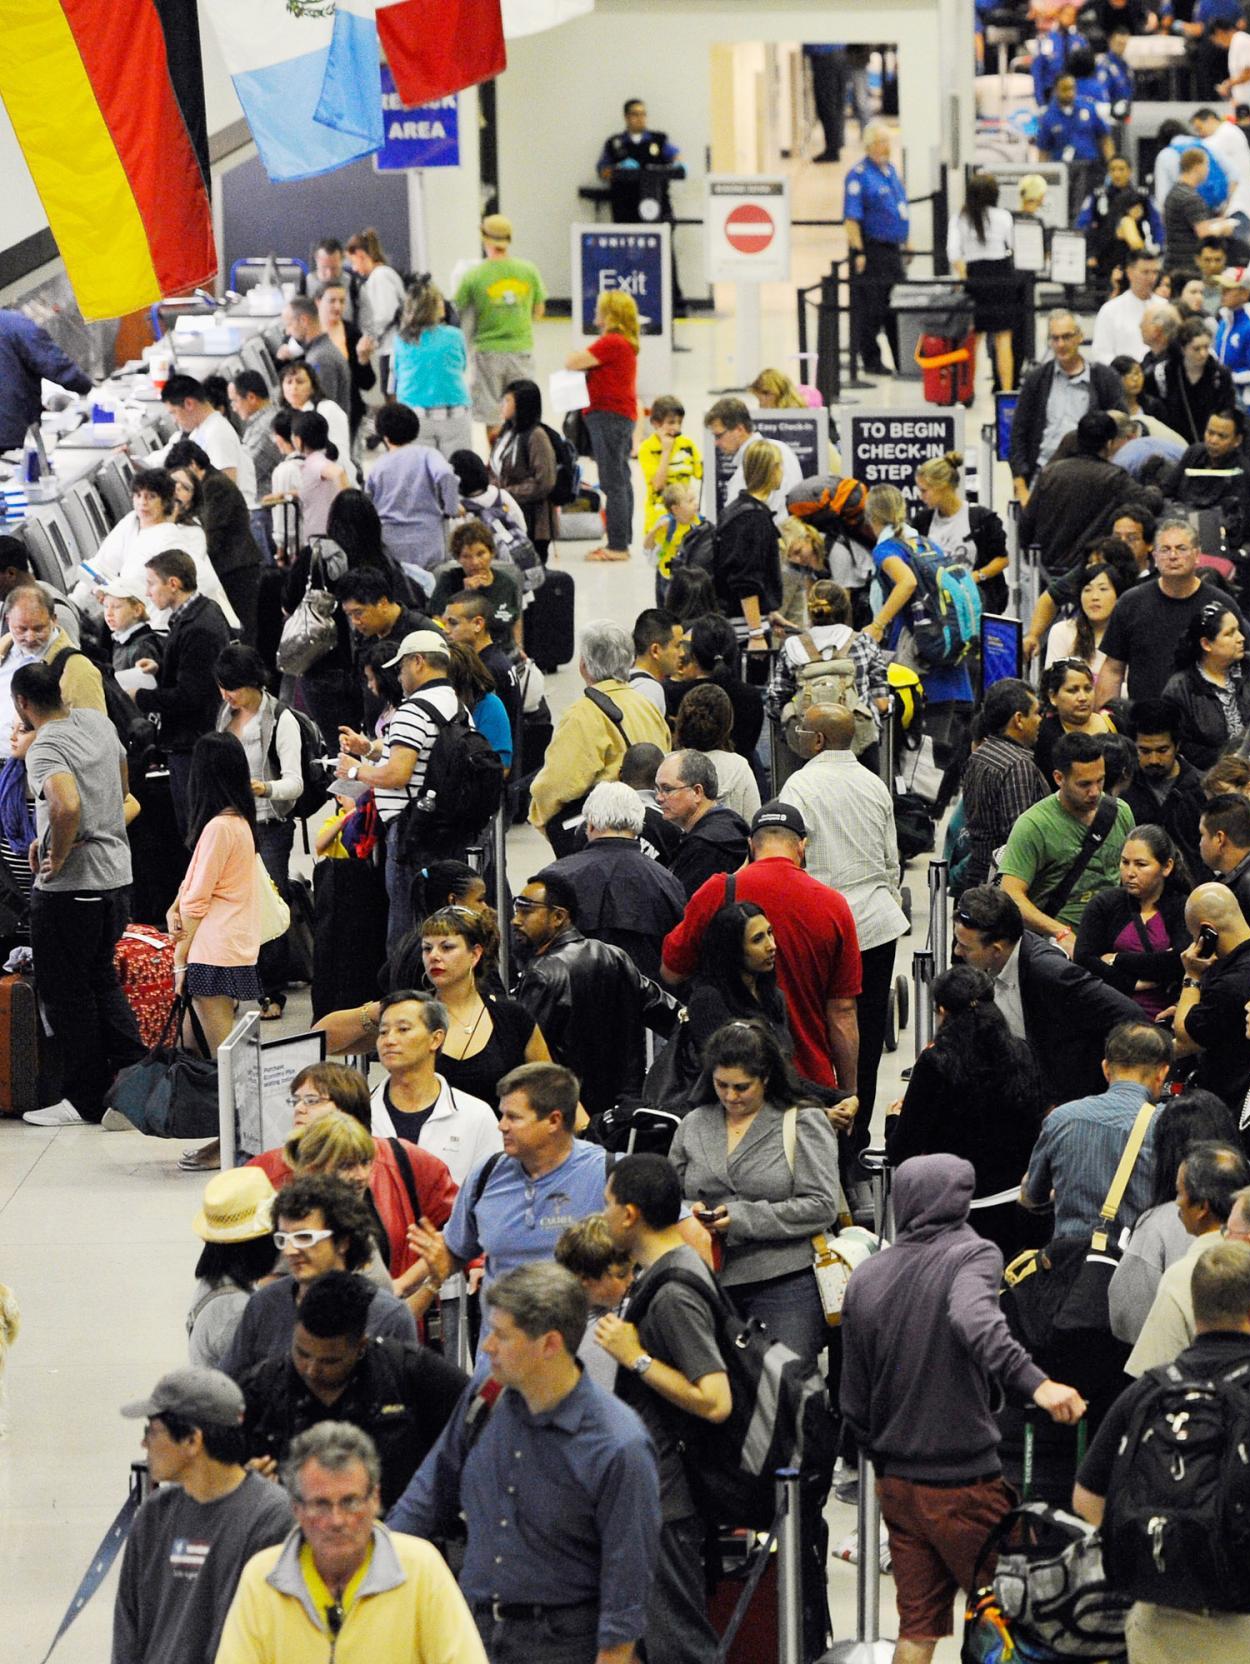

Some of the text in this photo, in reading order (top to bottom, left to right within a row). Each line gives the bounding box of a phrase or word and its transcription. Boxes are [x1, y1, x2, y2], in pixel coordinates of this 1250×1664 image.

[388, 121, 447, 139] AREA
[598, 269, 648, 295] Exit
[859, 422, 947, 438] TO BEGIN
[857, 443, 945, 460] CHECK-IN
[865, 464, 913, 481] STEP
